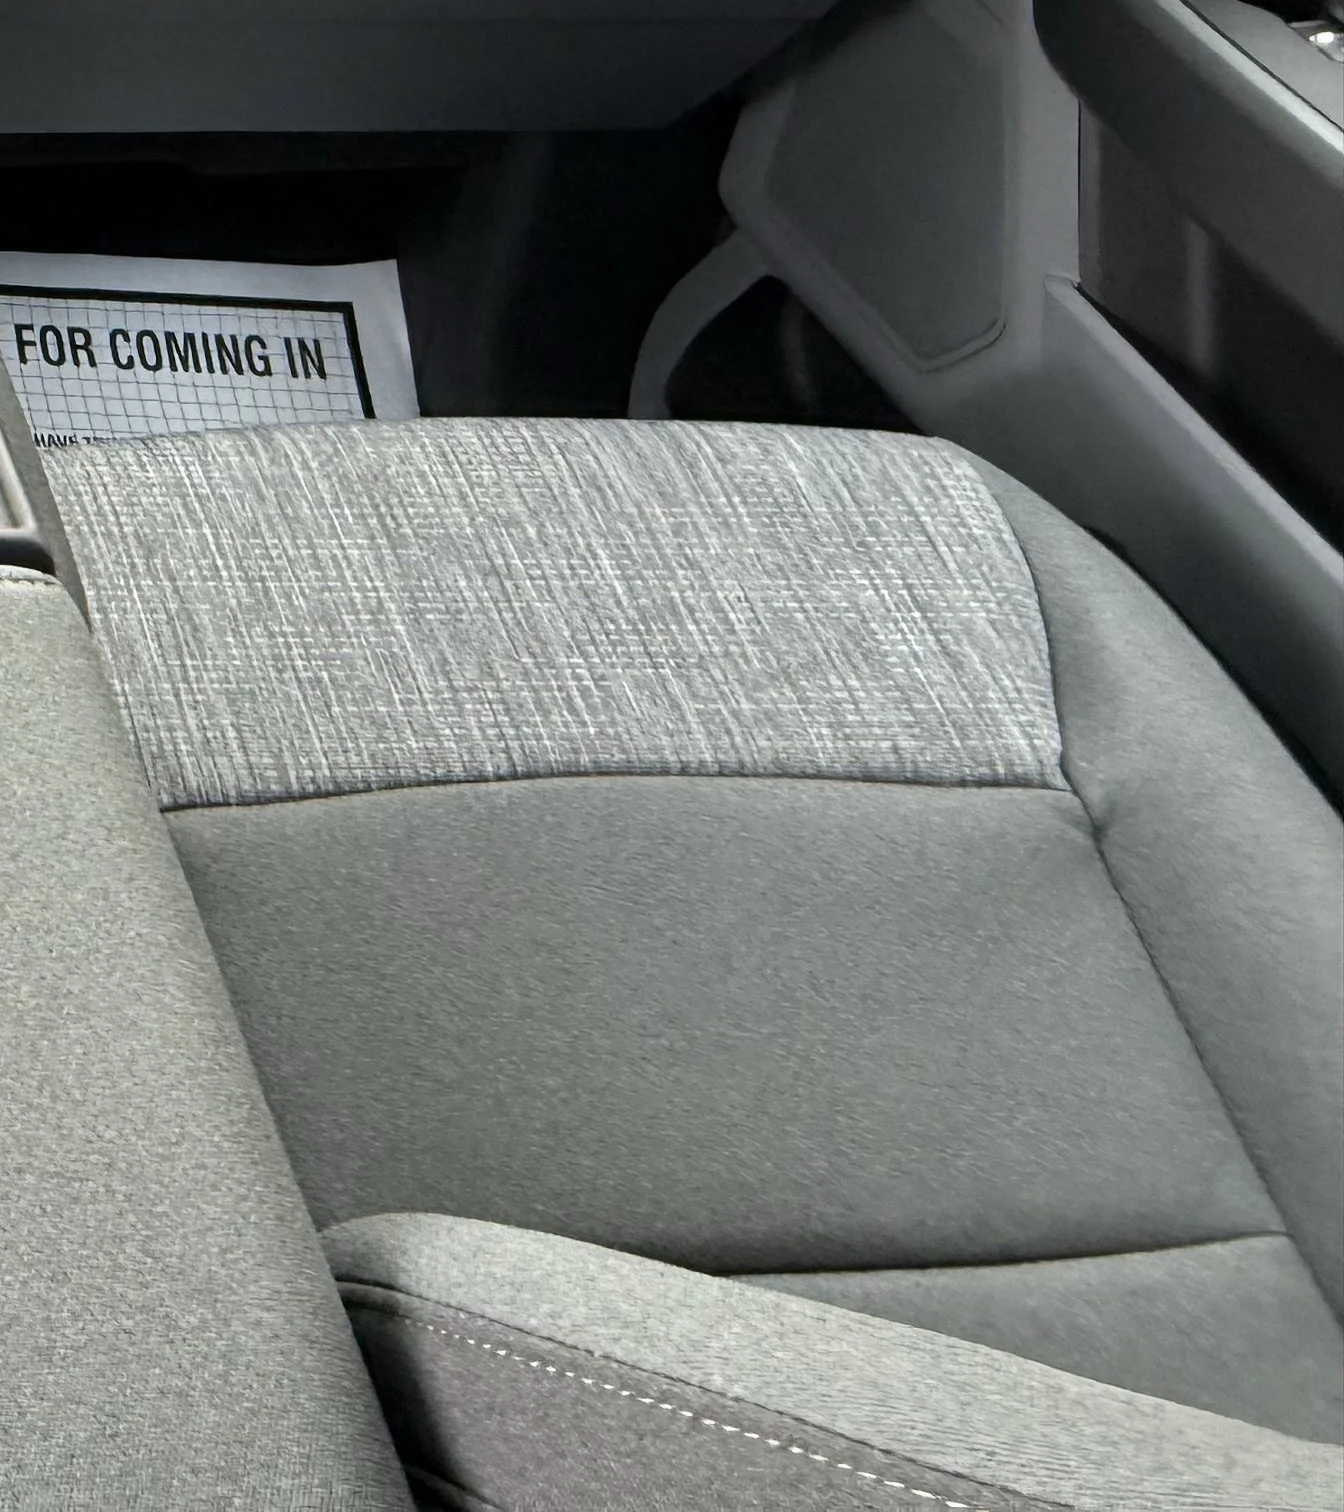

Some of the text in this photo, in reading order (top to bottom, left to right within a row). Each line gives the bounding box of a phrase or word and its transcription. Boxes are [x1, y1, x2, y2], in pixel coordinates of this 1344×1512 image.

[14, 324, 328, 381] FOR COMING IN
